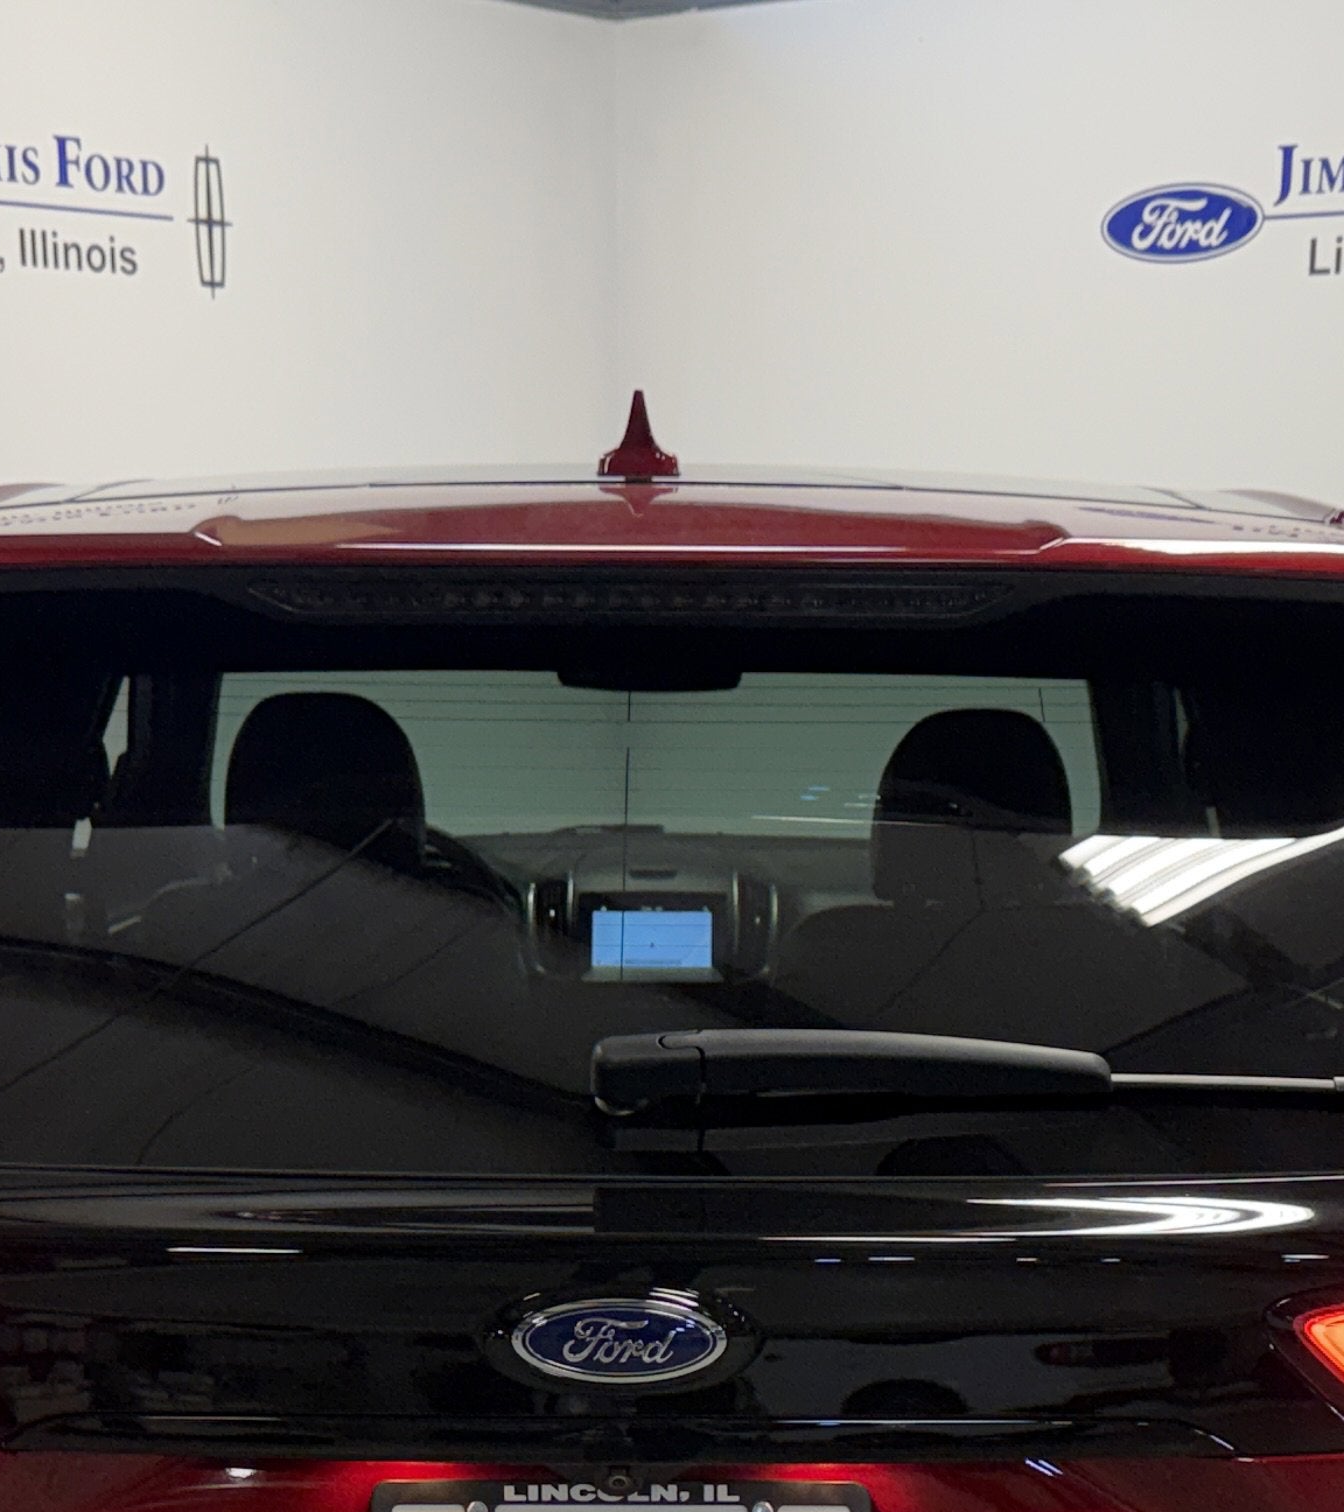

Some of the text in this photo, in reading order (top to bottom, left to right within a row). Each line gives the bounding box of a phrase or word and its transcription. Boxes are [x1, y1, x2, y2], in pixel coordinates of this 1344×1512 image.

[54, 135, 165, 197] FORD
[1132, 198, 1228, 248] Ford
[20, 229, 138, 275] Illinois
[562, 1317, 674, 1363] Ford
[703, 1484, 740, 1502] IL
